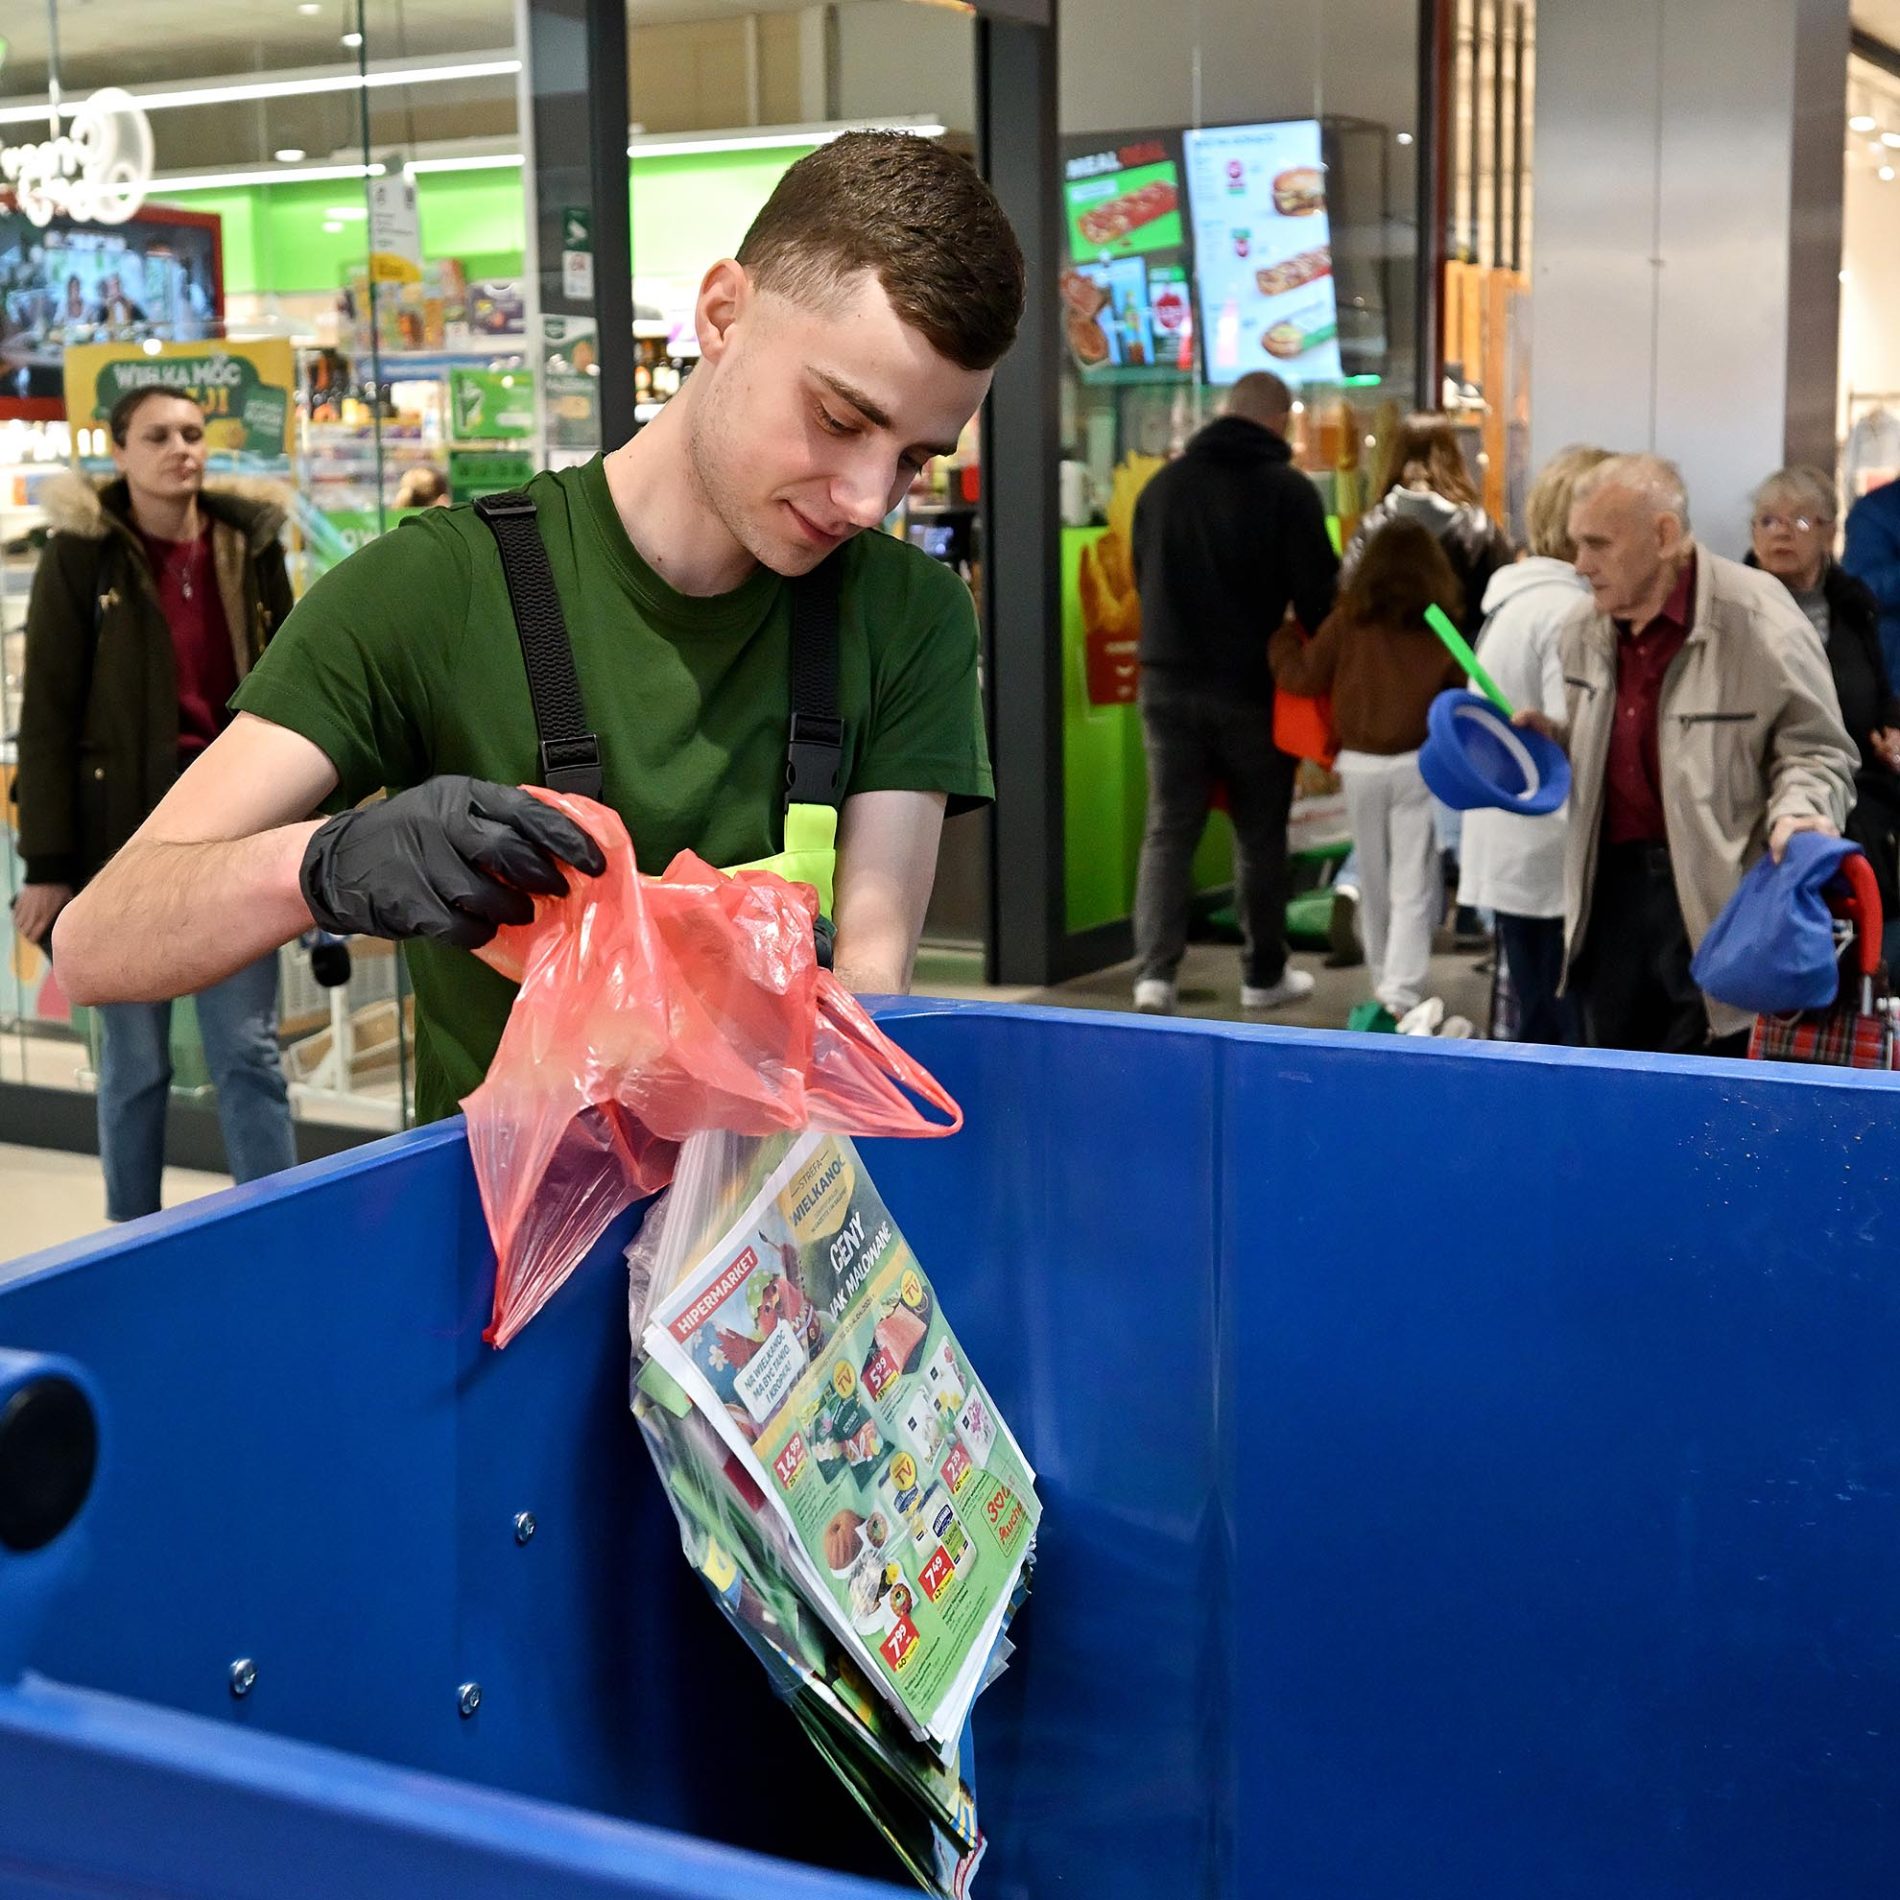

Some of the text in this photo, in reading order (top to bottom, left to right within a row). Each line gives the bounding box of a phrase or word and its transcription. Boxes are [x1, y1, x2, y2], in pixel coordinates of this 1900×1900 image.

[799, 1159, 823, 1188] STREFA
[829, 1211, 866, 1275] CENY
[828, 1287, 849, 1324] JAK
[844, 1220, 893, 1298] MALOWANE
[676, 1251, 755, 1335] HIPERMARKET
[904, 1276, 921, 1302] TV
[836, 1366, 852, 1393] TV
[895, 1457, 912, 1485] TV
